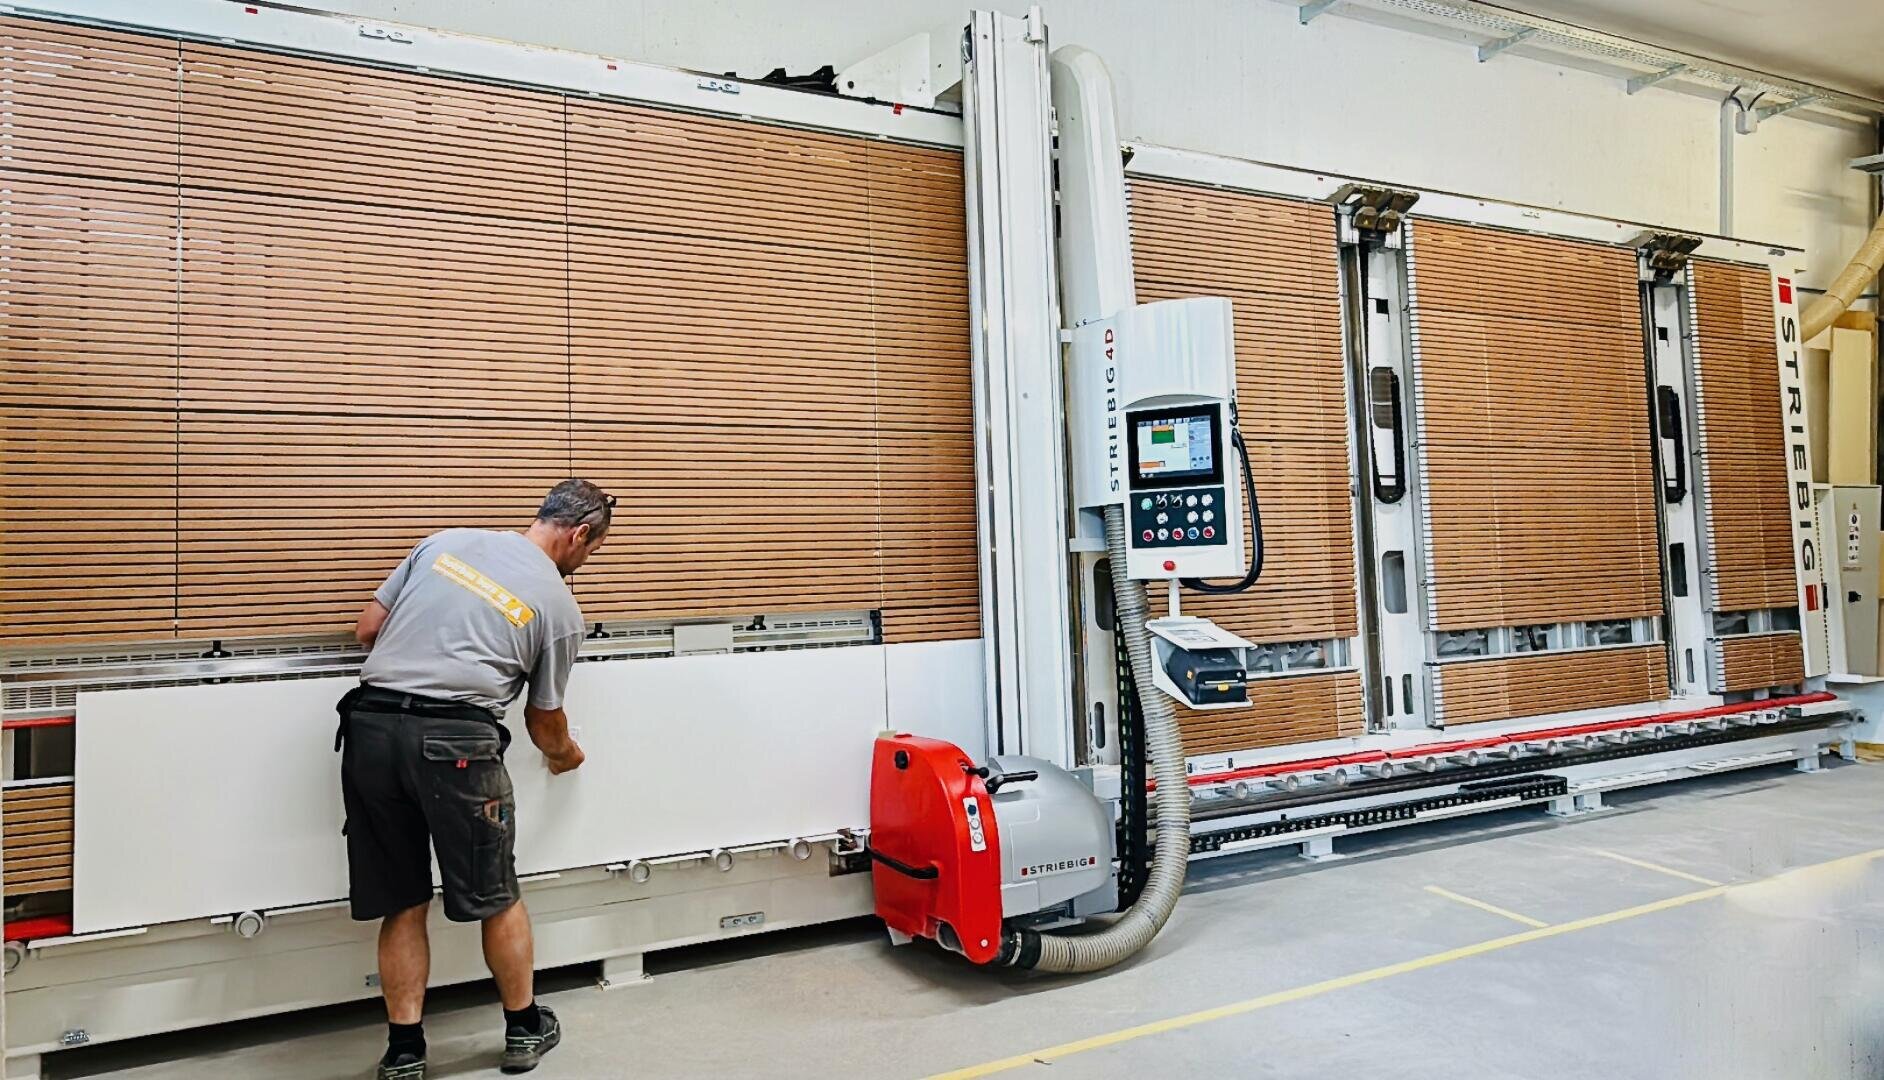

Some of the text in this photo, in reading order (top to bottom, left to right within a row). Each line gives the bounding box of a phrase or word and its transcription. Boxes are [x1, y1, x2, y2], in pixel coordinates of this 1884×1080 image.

[1104, 328, 1120, 492] STRIEBIG 4D
[1781, 316, 1815, 571] STRIEBIG
[1030, 858, 1088, 875] STRIEBIG
